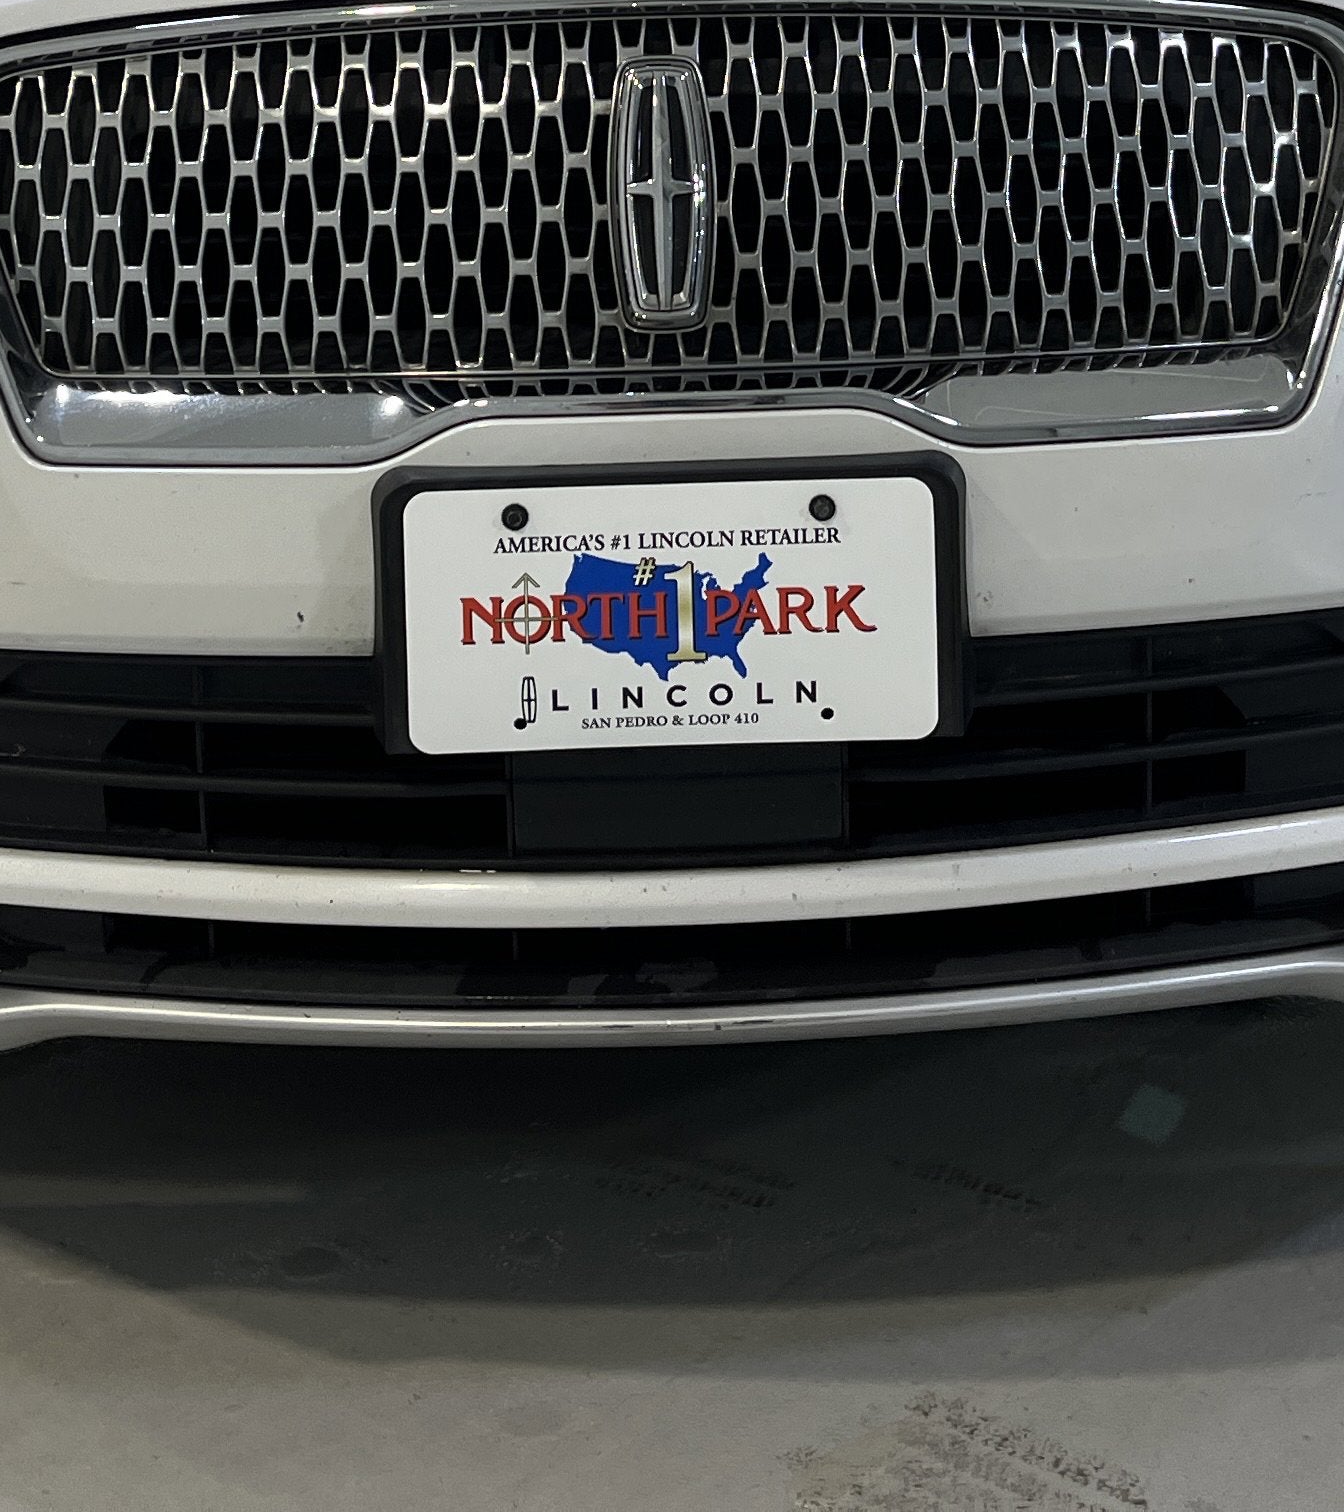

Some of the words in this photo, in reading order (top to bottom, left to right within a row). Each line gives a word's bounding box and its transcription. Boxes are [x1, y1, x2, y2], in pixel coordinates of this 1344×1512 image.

[493, 534, 605, 554] AMERICA'S
[610, 534, 631, 550] #1
[638, 530, 735, 550] LINCOLN
[740, 527, 842, 547] RETAILER
[460, 591, 668, 645] NORTH
[705, 584, 878, 637] PARK
[551, 680, 817, 712] LINCOLN
[581, 717, 611, 730] SAN
[615, 716, 668, 729] PEDRO
[672, 715, 684, 727] &
[688, 714, 731, 727] LOOP
[734, 712, 759, 725] 410
